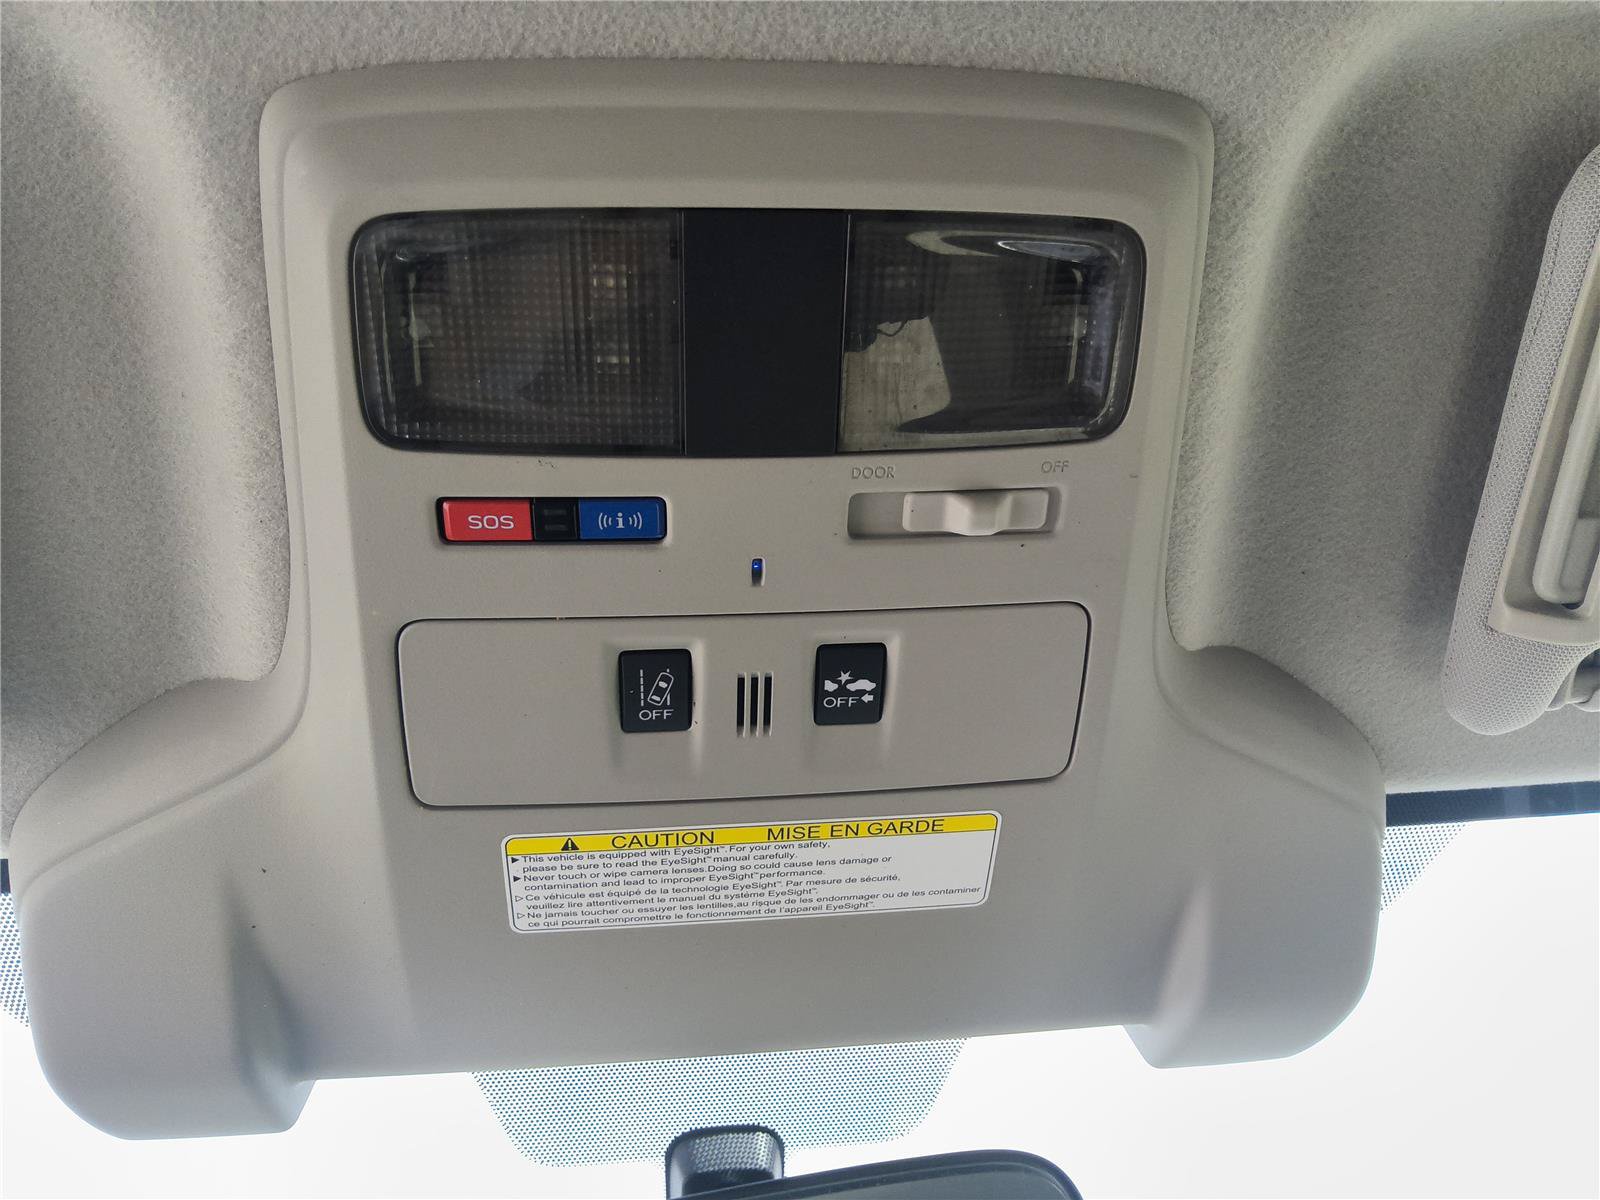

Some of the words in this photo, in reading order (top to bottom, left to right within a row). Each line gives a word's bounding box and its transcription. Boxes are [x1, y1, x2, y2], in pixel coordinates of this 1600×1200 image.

[851, 466, 895, 480] DOOR
[1041, 460, 1069, 474] OFF
[468, 515, 515, 530] SOS
[823, 697, 860, 708] OFF
[638, 708, 674, 720] OFF
[611, 831, 714, 849] CAUTION
[767, 826, 821, 840] MISE
[830, 823, 860, 837] EN
[867, 819, 945, 835] GARDE
[522, 855, 544, 863] This
[547, 854, 584, 862] vehicle
[599, 850, 646, 860] equipped
[749, 844, 771, 853] your
[522, 865, 557, 874] please
[560, 863, 574, 871] be
[713, 854, 750, 862] manual
[753, 852, 798, 860] carefully.
[523, 874, 555, 882] Never
[558, 872, 587, 880] touch
[603, 870, 627, 878] wipe
[754, 862, 780, 870] could
[784, 860, 813, 868] cause
[816, 857, 836, 866] lens
[839, 857, 879, 865] damage
[524, 881, 598, 891] contamination
[661, 876, 706, 885] improper
[544, 891, 586, 900] véhicule
[608, 889, 641, 897] équipé
[672, 884, 729, 893] technologie
[786, 879, 802, 887] Par
[806, 878, 842, 886] mesure
[527, 901, 565, 910] veuillez
[586, 897, 654, 907] attentivement
[669, 894, 706, 902] manuel
[724, 890, 765, 901] système
[544, 910, 578, 919] jamais
[581, 908, 618, 916] toucher
[637, 905, 676, 914] essuyer
[816, 893, 880, 903] endommager
[897, 890, 909, 898] de
[928, 886, 981, 896] contaminer
[561, 918, 600, 926] pourrait
[603, 913, 671, 924] compromettre
[686, 907, 761, 919] fonctionnement
